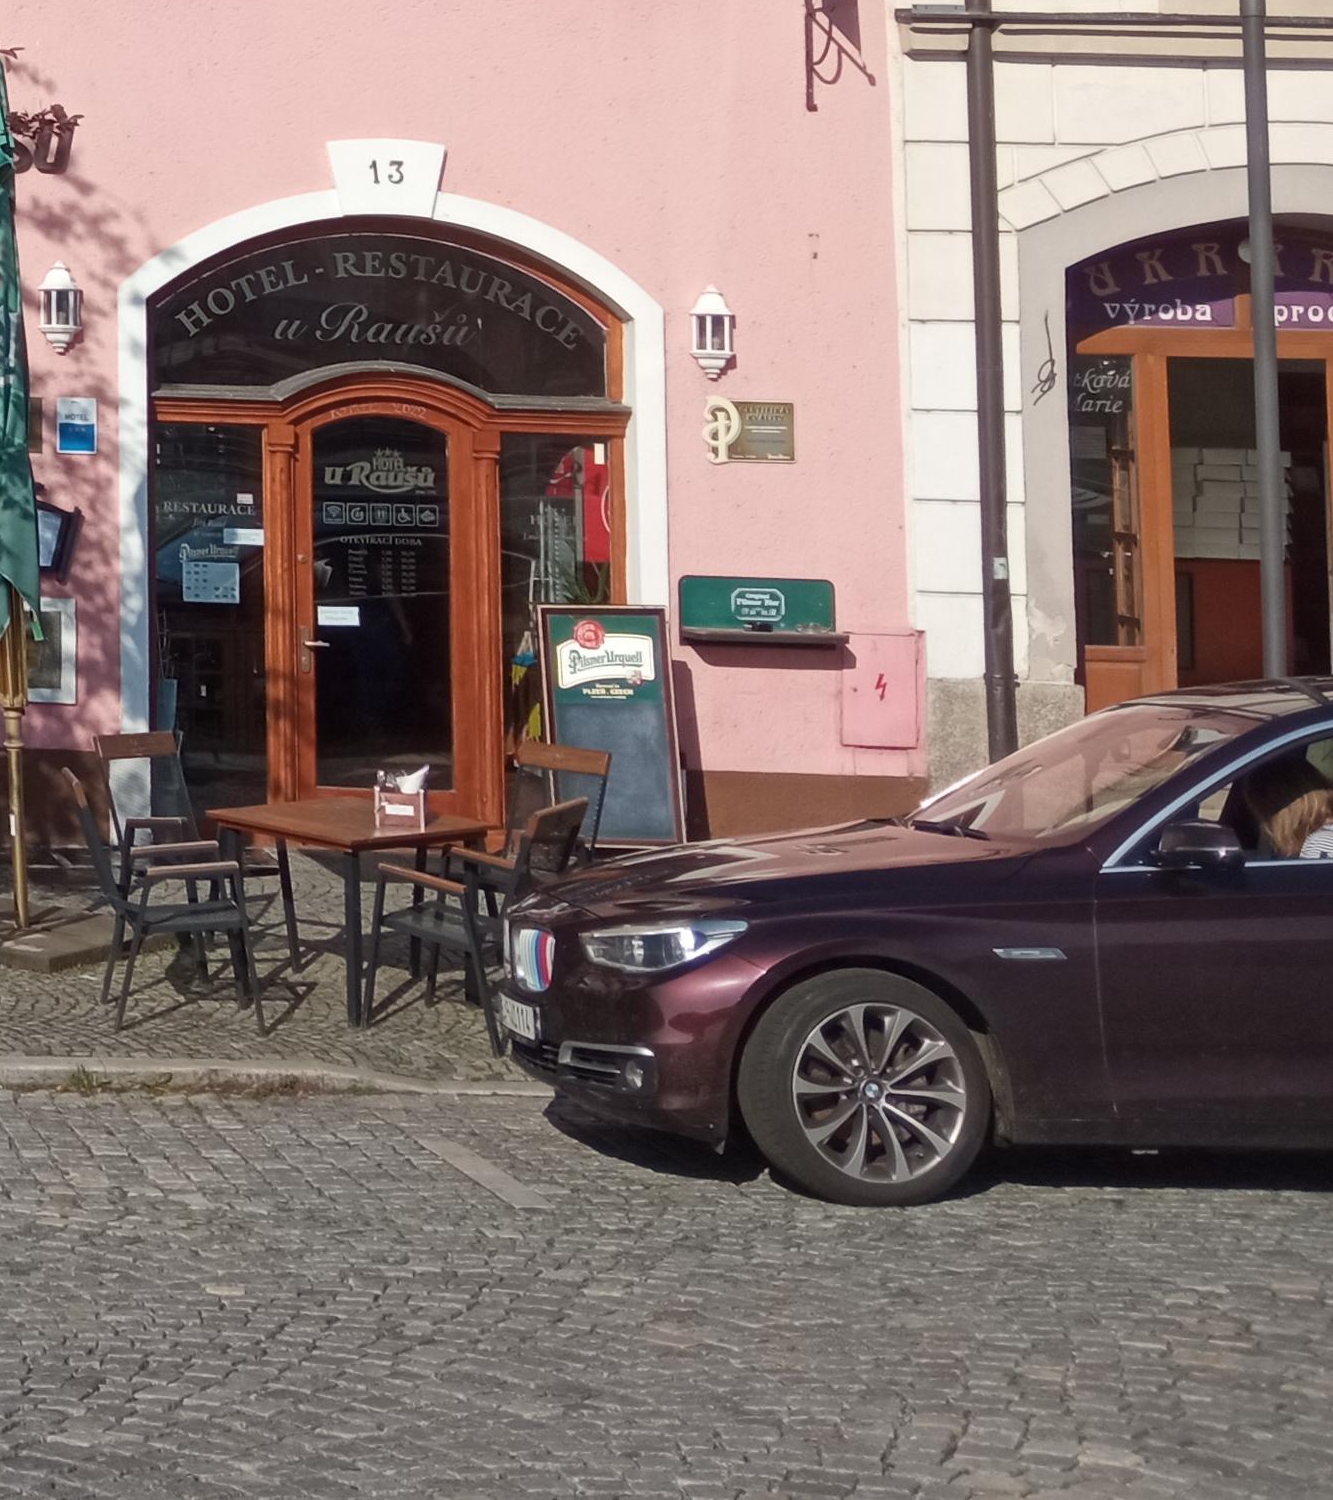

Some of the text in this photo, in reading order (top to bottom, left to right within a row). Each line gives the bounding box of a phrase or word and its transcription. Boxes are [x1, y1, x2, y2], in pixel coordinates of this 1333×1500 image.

[369, 159, 404, 184] 13
[175, 258, 308, 338] HOTEL
[334, 250, 585, 350] RESTAURACE
[1104, 298, 1213, 325] výroba
[316, 301, 478, 347] Raušů
[64, 413, 89, 421] HOTEL
[372, 457, 405, 473] HOTEL
[163, 501, 256, 515] RESTAURACE
